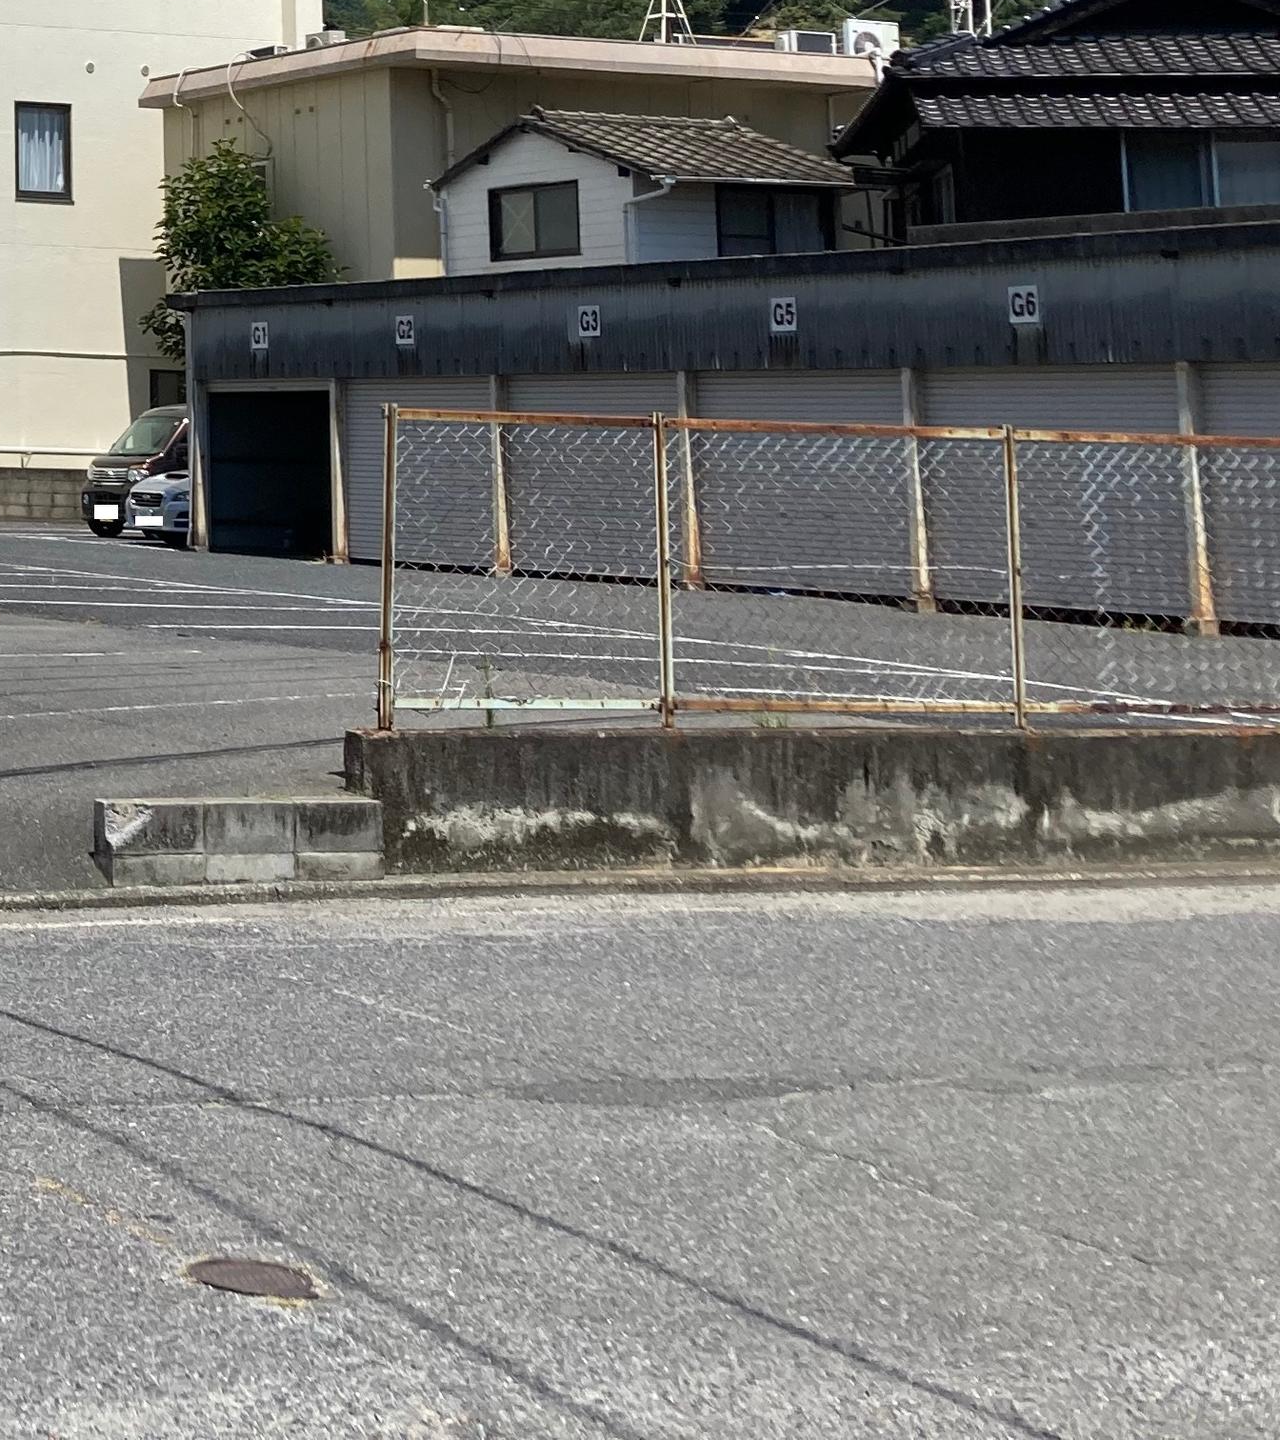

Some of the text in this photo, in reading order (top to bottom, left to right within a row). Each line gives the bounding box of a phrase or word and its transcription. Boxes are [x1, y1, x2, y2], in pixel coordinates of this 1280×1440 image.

[773, 303, 796, 326] G5
[1011, 292, 1036, 317] G6
[397, 320, 413, 339] G2
[580, 310, 598, 331] G3
[253, 327, 266, 344] G1
